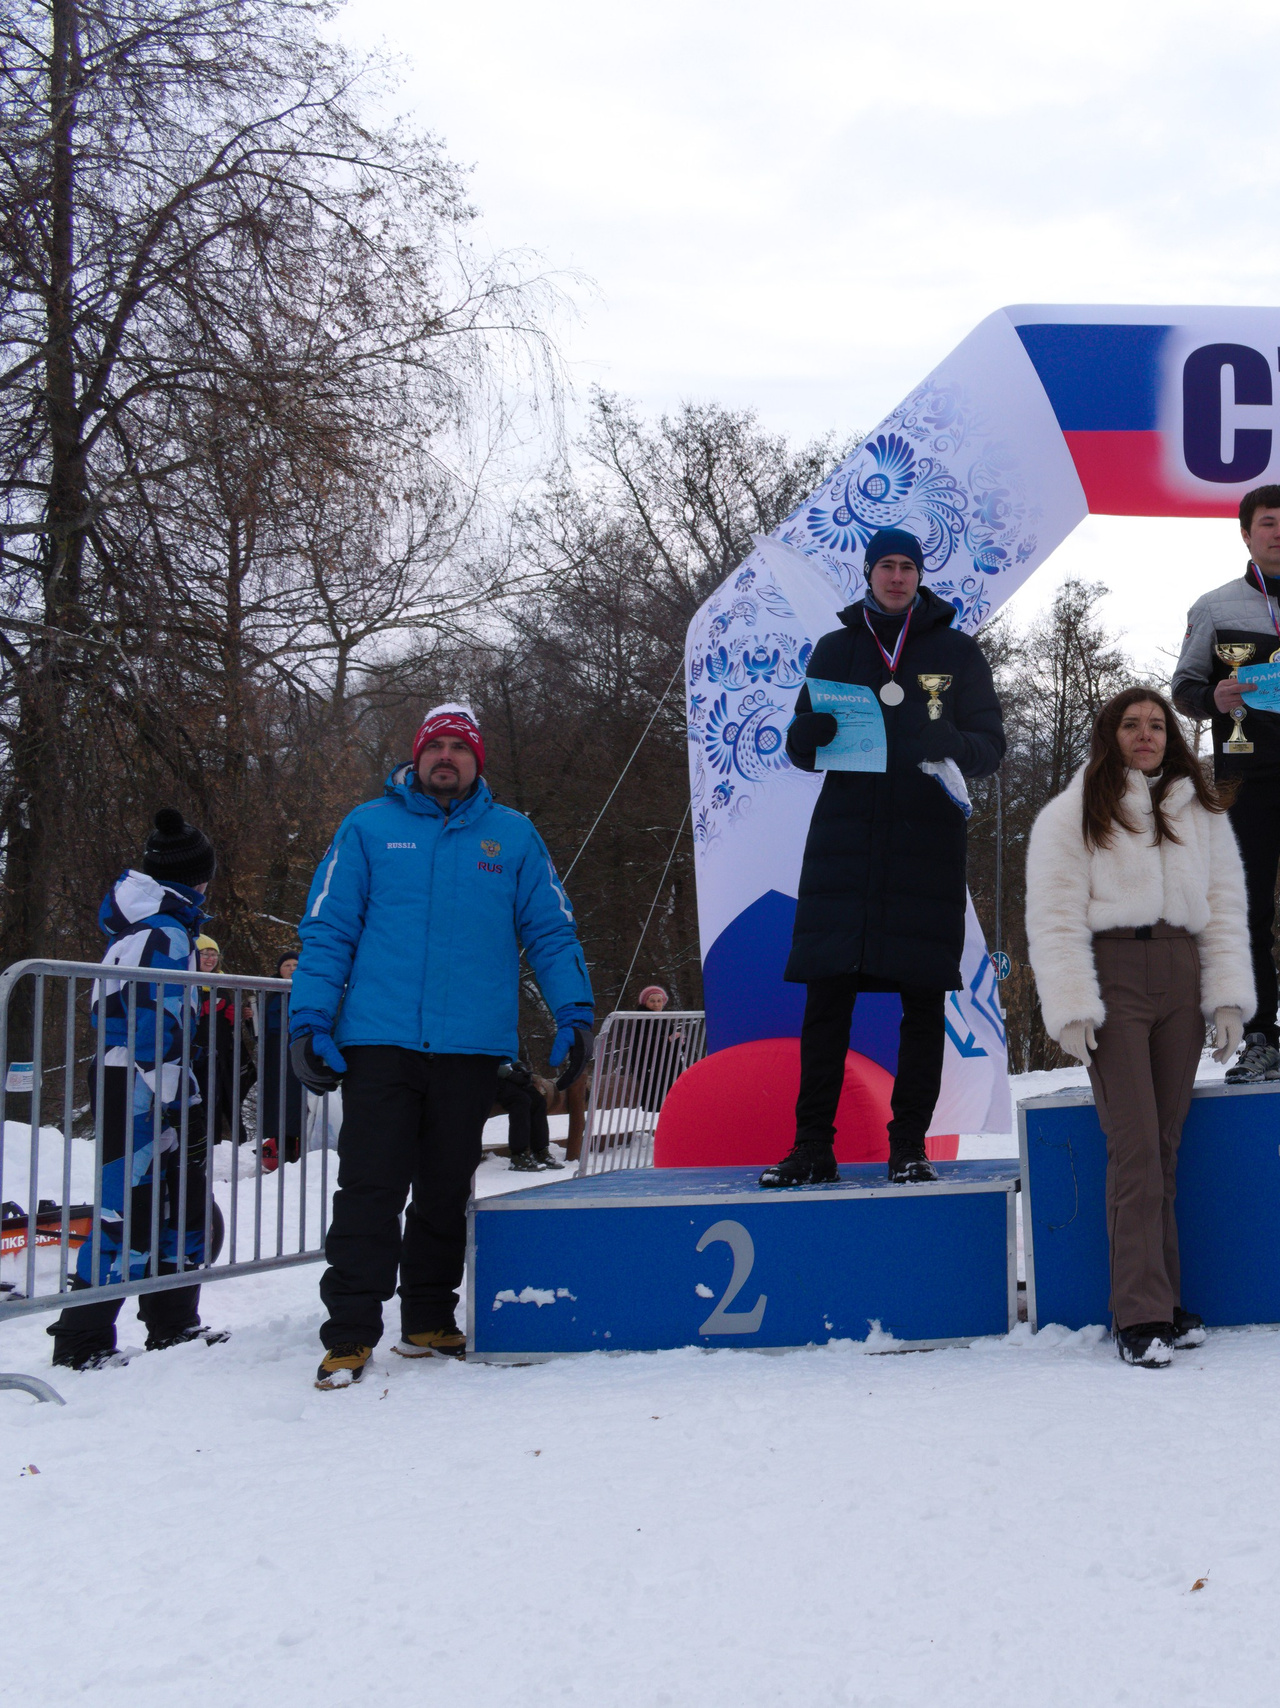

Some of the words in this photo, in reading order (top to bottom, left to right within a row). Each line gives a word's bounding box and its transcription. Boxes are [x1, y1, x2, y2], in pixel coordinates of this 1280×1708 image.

[816, 693, 871, 703] ГРАМОТА
[416, 718, 480, 748] 2026
[477, 861, 503, 874] RUS
[696, 1219, 768, 1336] 2
